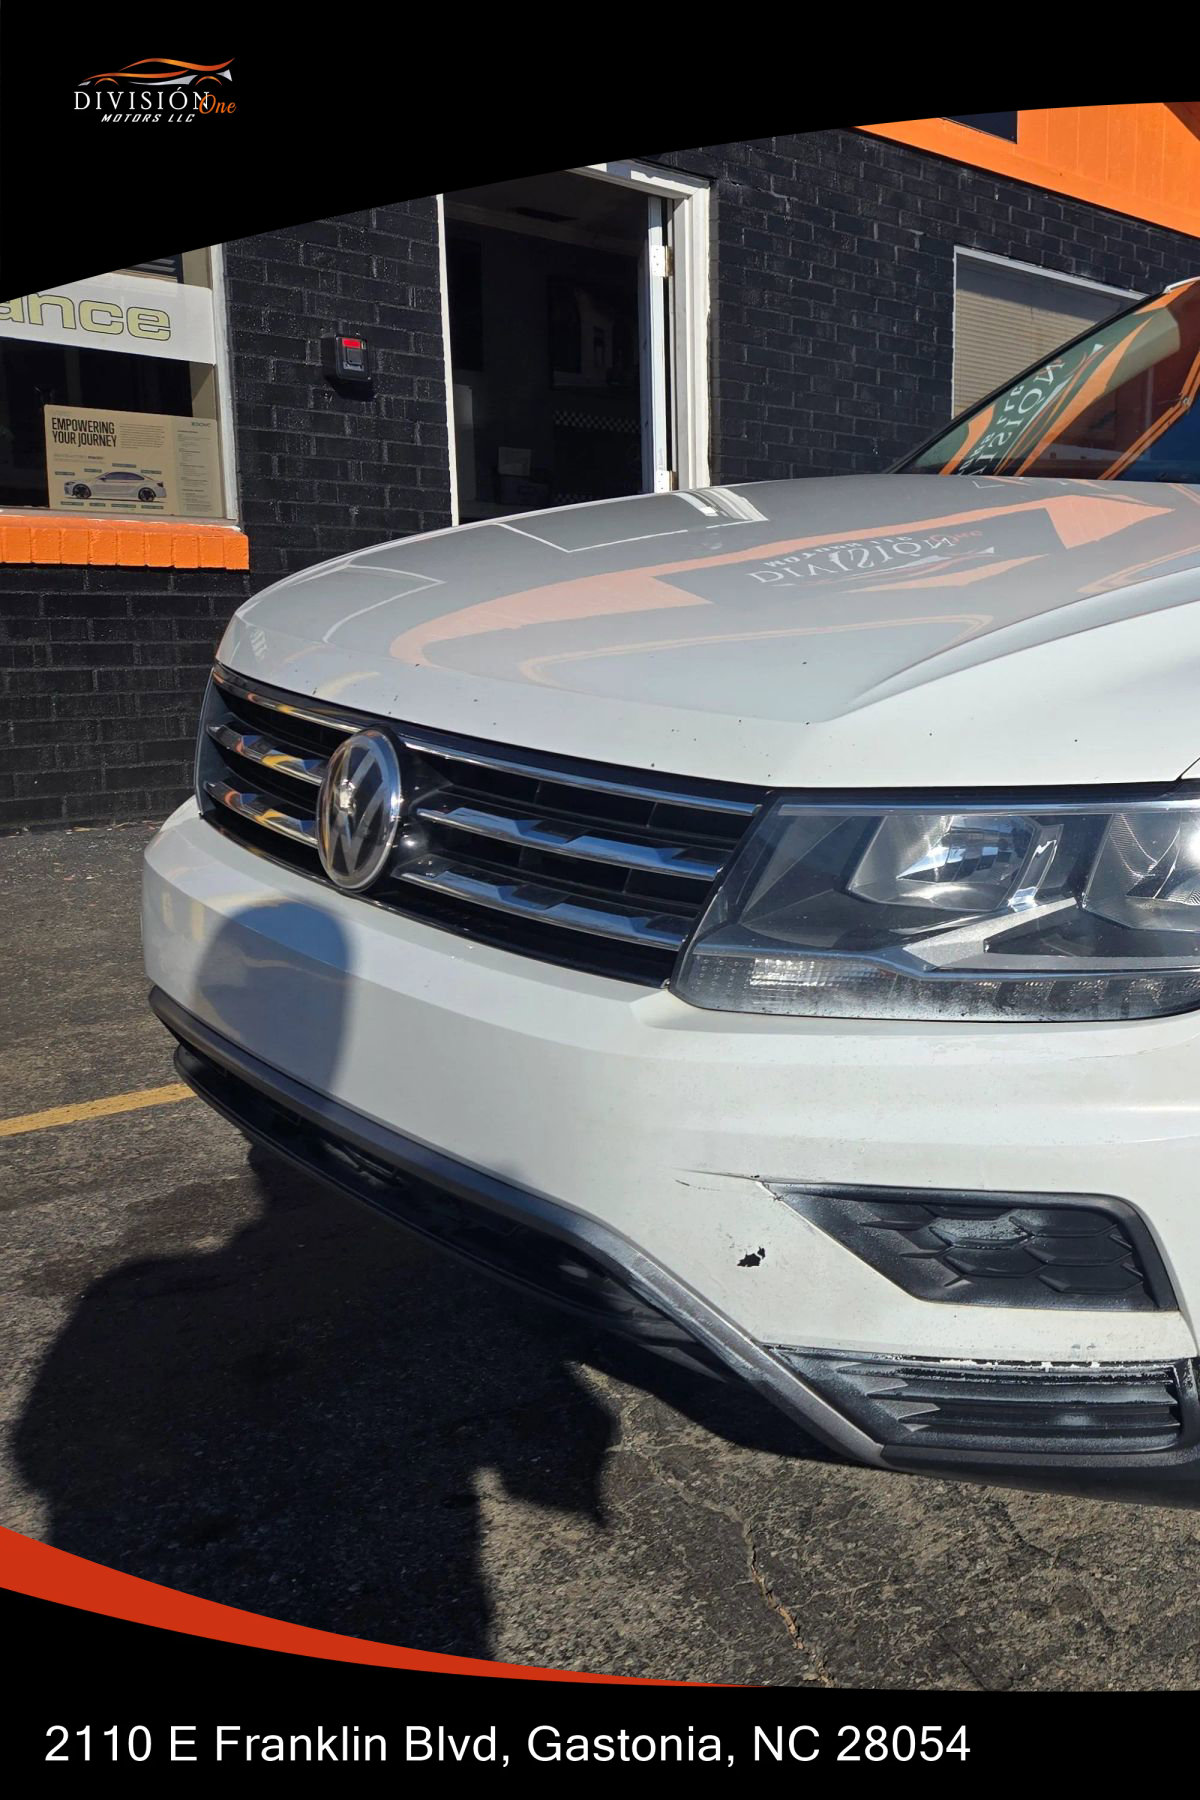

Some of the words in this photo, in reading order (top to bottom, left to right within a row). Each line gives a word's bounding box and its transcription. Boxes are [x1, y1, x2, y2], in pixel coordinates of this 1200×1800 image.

[52, 417, 115, 434] EMPOWERING
[52, 430, 76, 445] YOUR
[78, 432, 117, 447] JOURNEY
